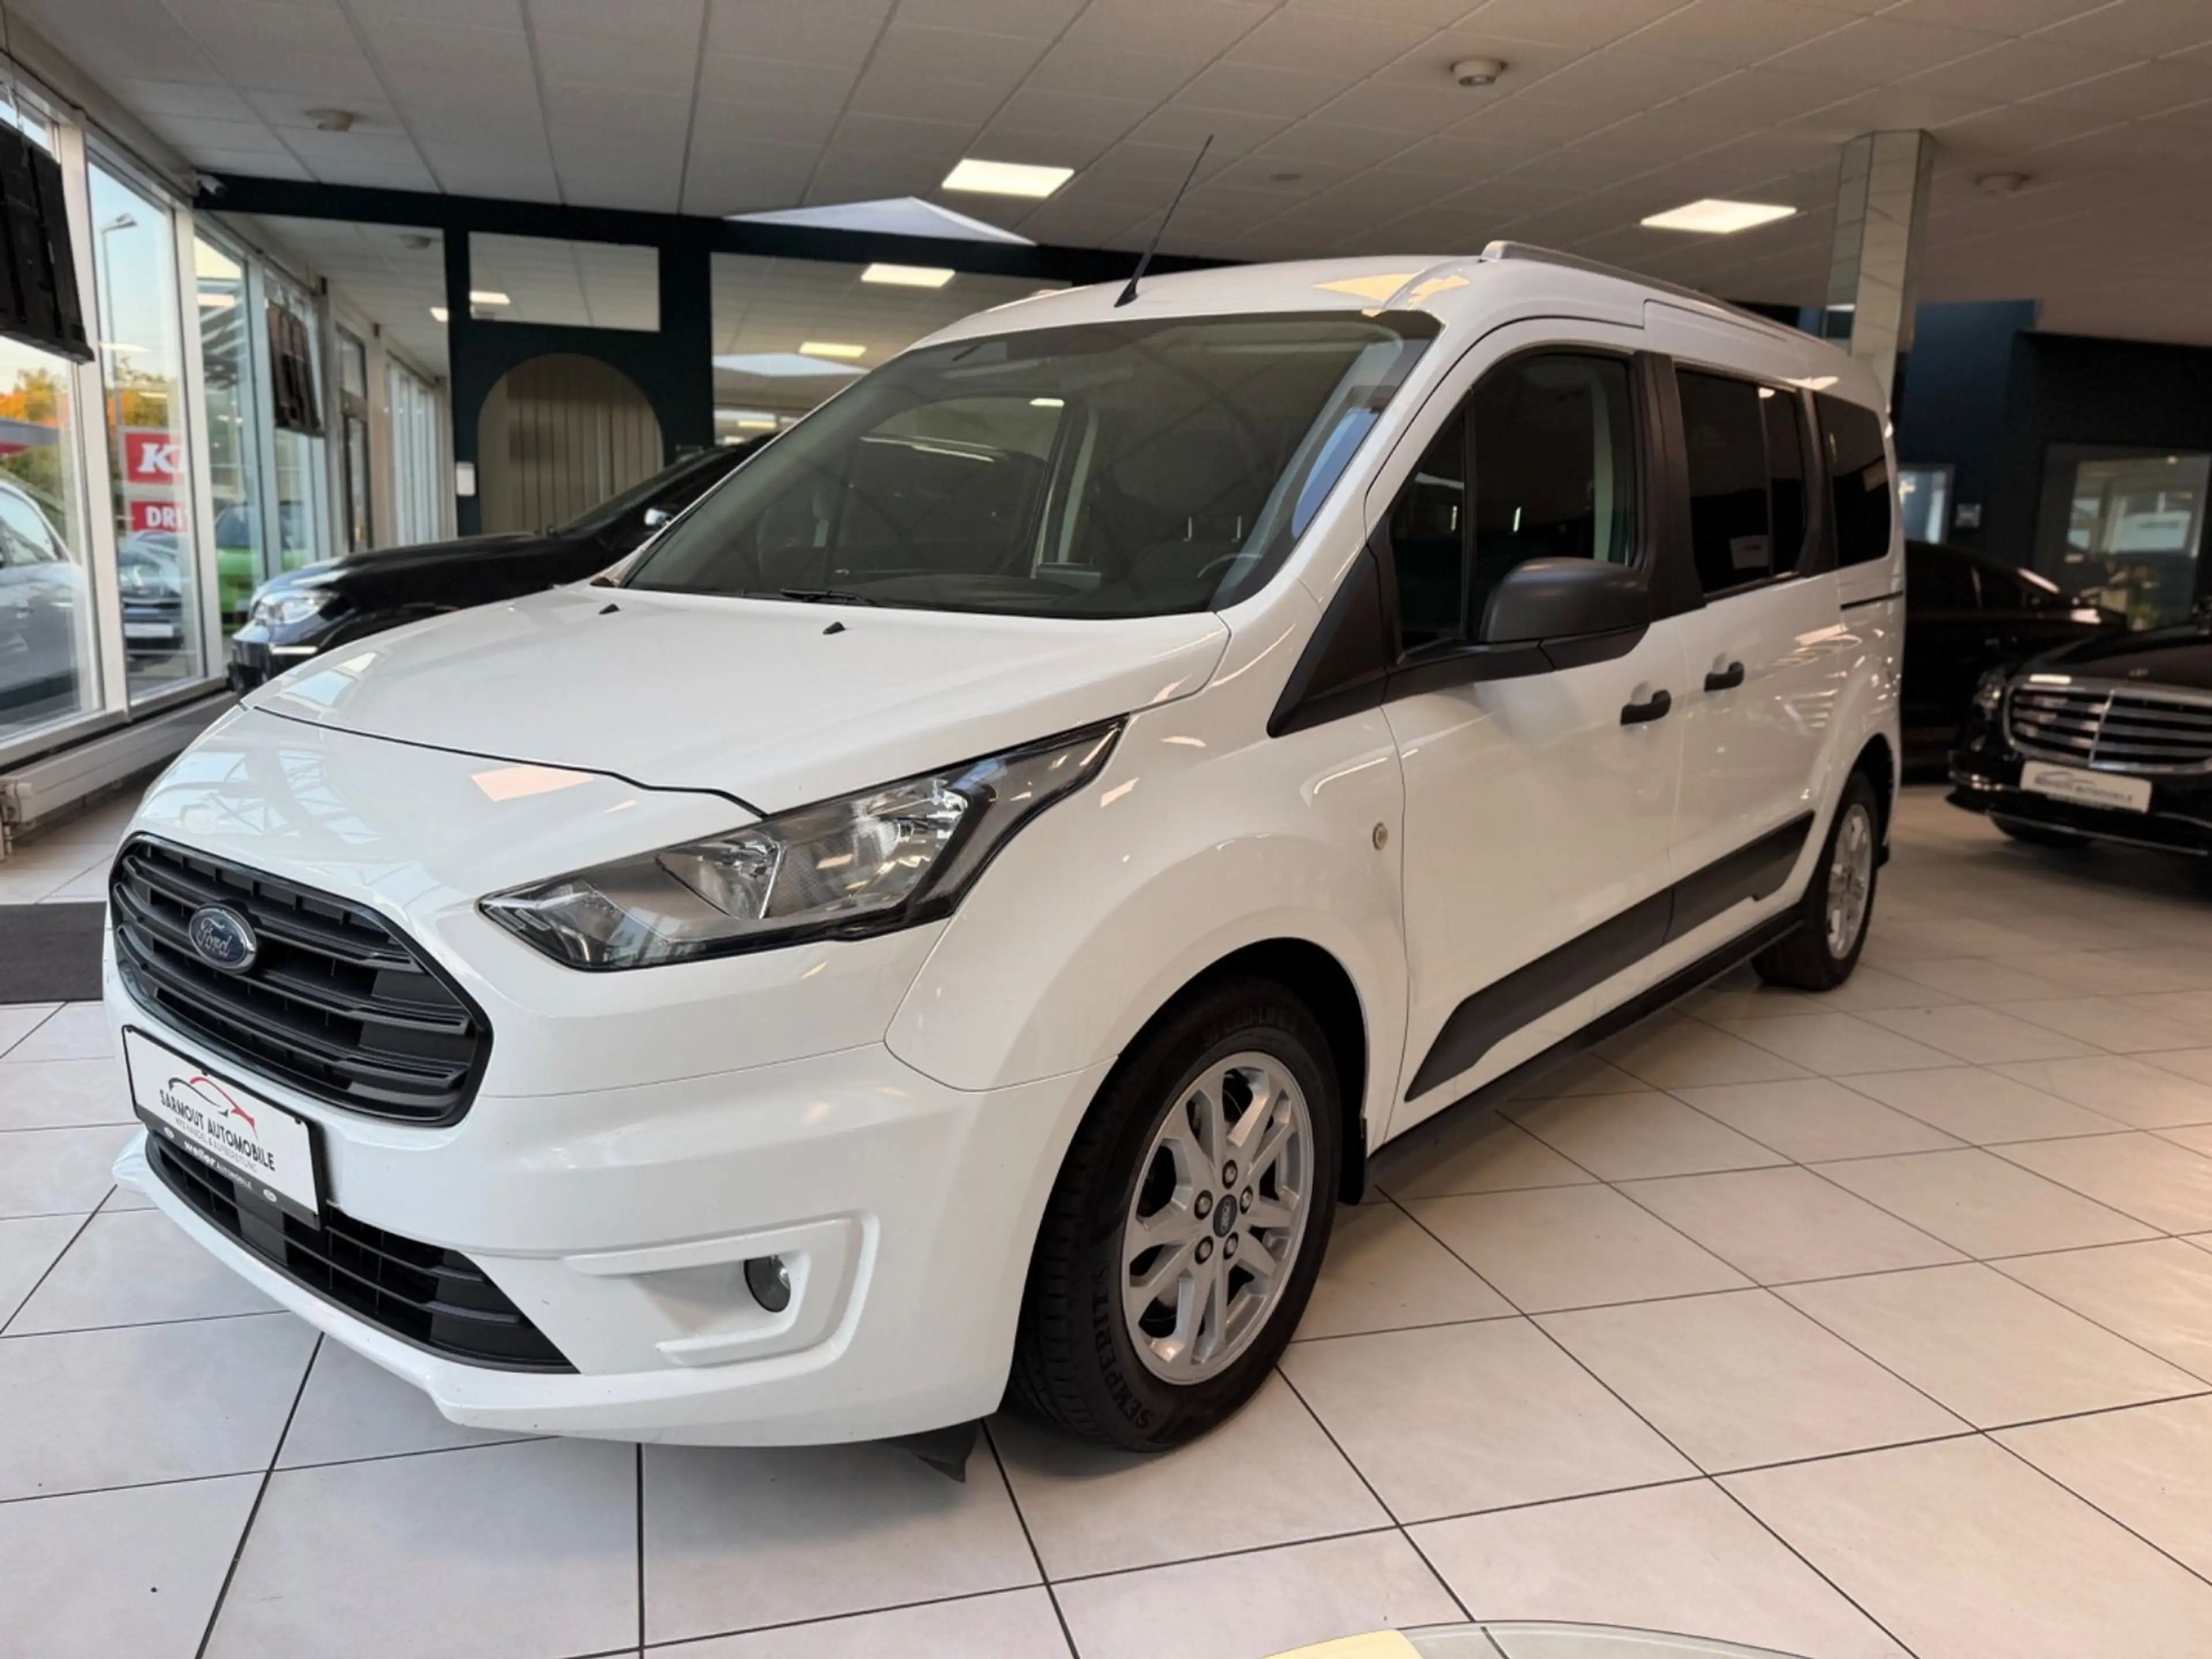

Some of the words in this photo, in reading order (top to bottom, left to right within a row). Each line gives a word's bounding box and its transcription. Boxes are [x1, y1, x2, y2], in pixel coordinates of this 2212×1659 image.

[196, 916, 233, 957] Ford
[207, 1118, 275, 1172] AUTOMOBILE
[1091, 1291, 1154, 1429] SEMPERIT
